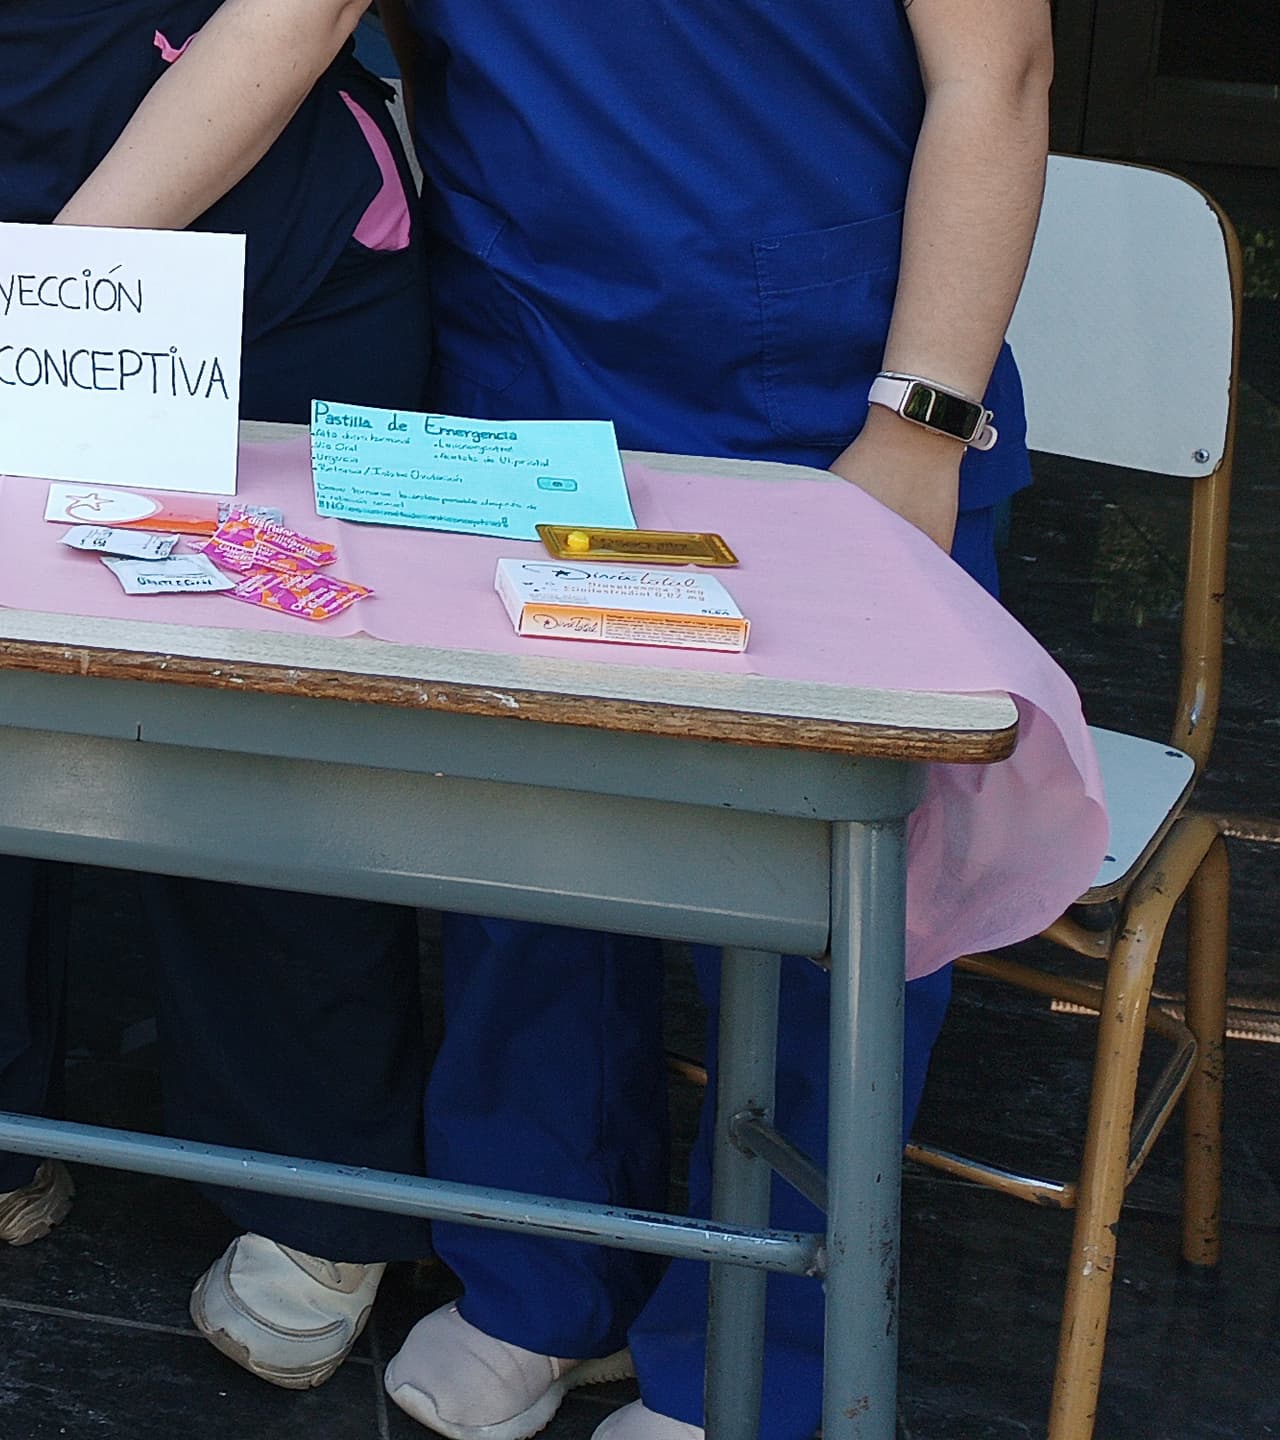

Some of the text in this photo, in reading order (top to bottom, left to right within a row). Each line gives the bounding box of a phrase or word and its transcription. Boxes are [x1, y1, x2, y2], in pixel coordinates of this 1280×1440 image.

[315, 402, 372, 429] Pastilla
[388, 414, 408, 432] de
[425, 416, 518, 442] Emergencia
